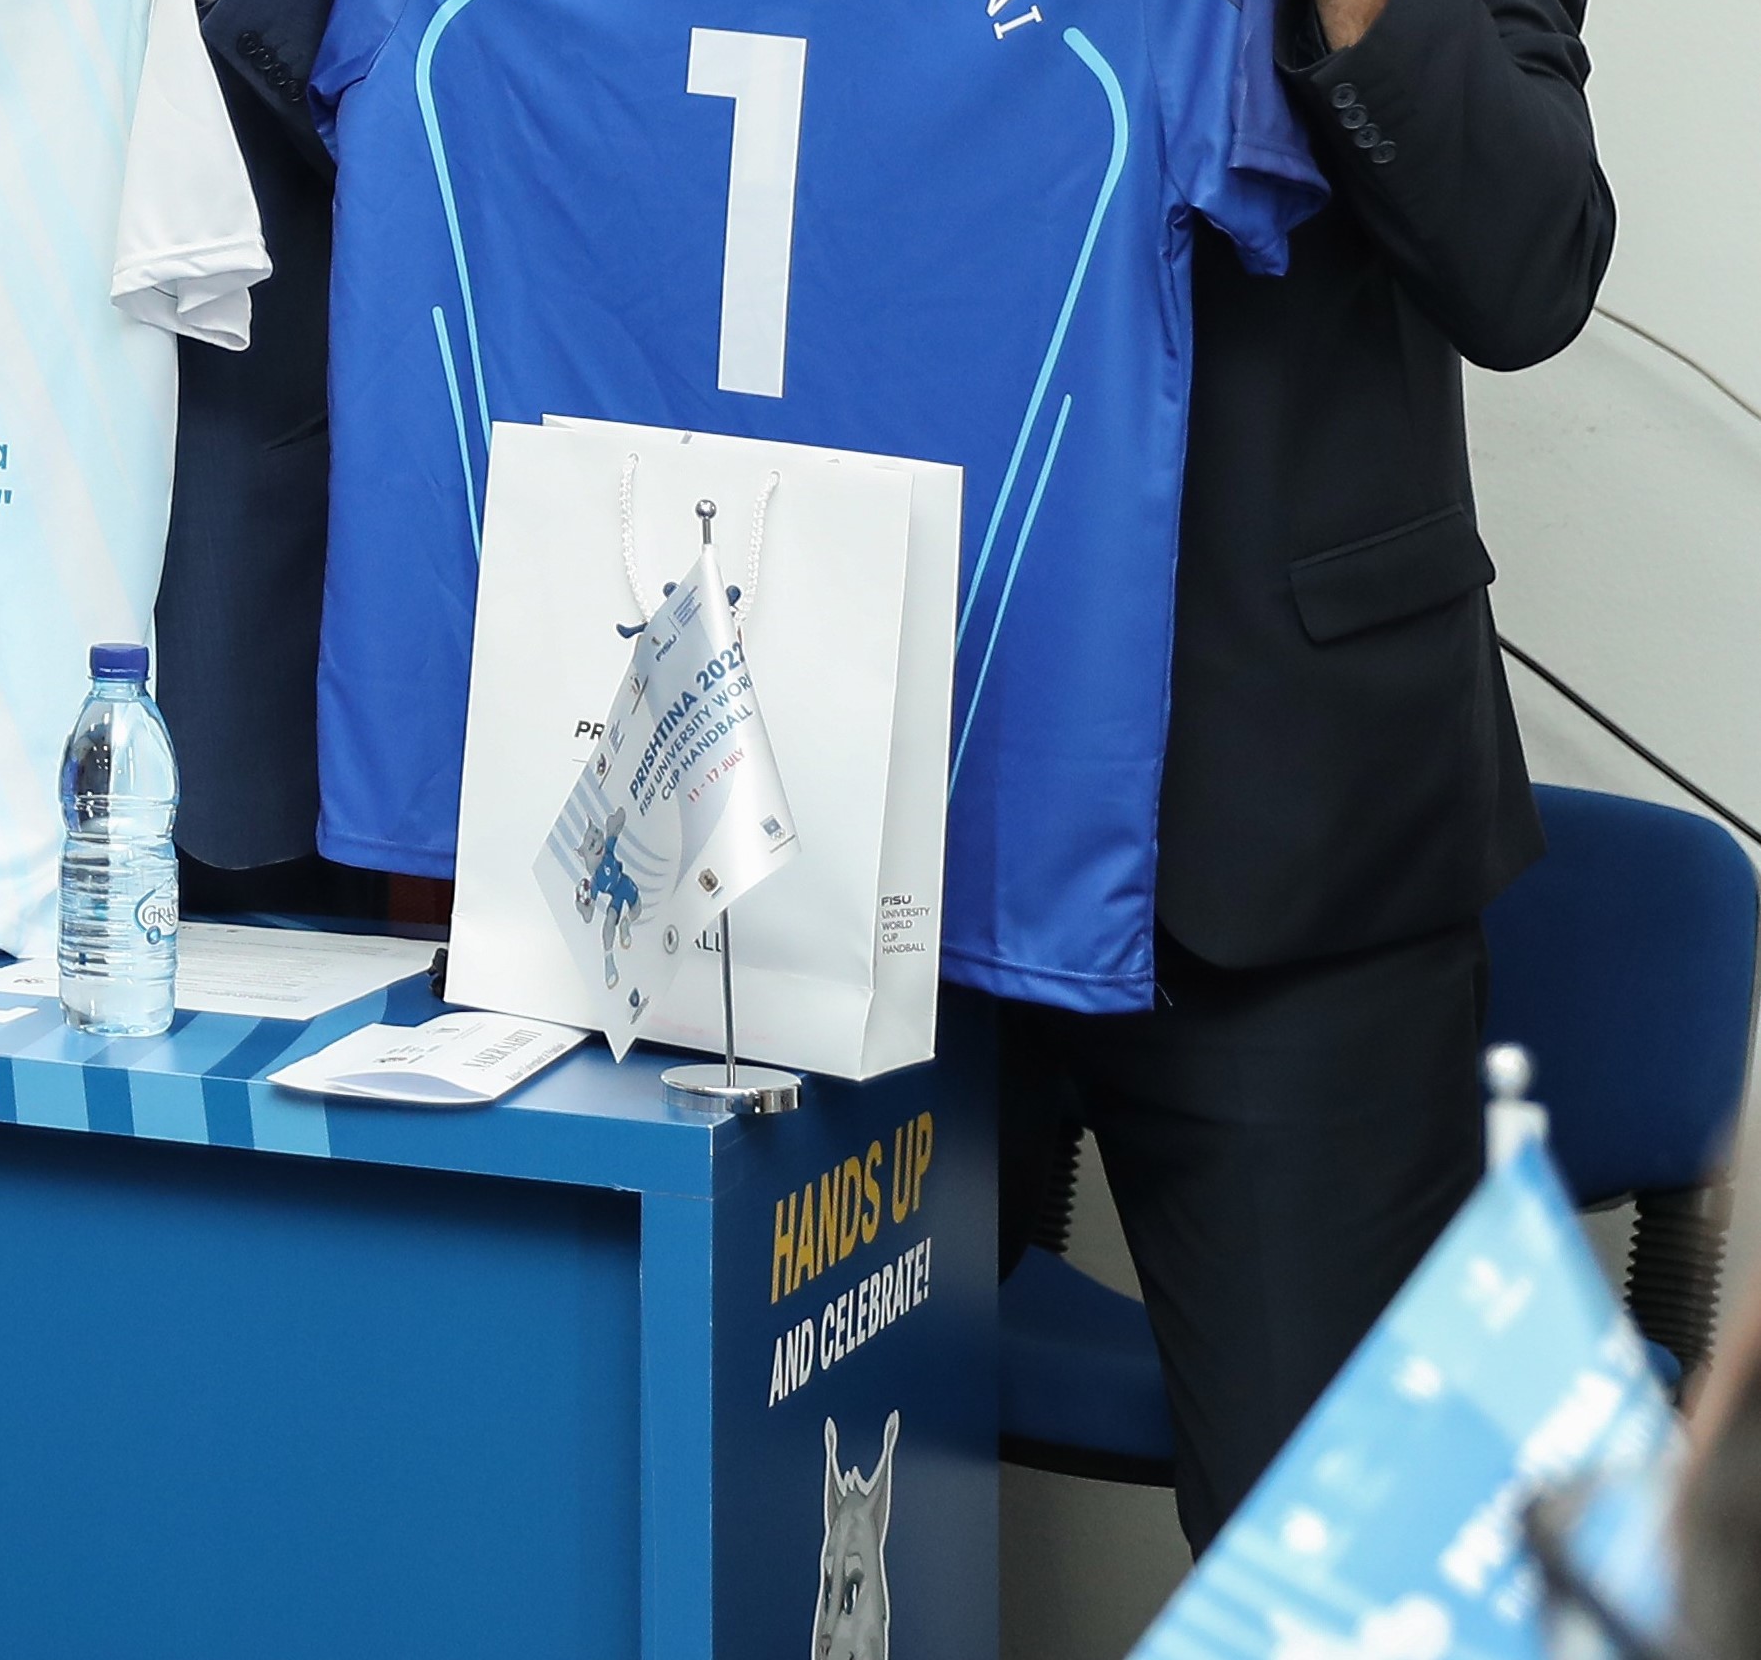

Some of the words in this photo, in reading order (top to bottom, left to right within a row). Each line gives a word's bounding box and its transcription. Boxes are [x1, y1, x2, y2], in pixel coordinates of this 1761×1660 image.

[685, 26, 808, 399] 1
[655, 636, 677, 662] FISU
[629, 690, 698, 800] PRISHTINA
[696, 642, 745, 692] 2022
[639, 782, 657, 816] FISU
[654, 704, 712, 781] UNIVERSITY
[661, 769, 681, 801] CUP
[682, 703, 753, 771] HANDBALL
[687, 786, 700, 803] 11
[706, 769, 720, 785] 17
[721, 748, 746, 773] JULY
[881, 895, 911, 906] FISU
[881, 907, 930, 918] UNIVERSITY
[881, 920, 913, 930] WORLD
[882, 933, 899, 943] CUP
[882, 943, 926, 954] HANDBALL
[770, 1140, 883, 1305] HANDS
[891, 1111, 934, 1224] UP
[768, 1317, 815, 1408] AND
[820, 1237, 932, 1371] CELEBRATE!
